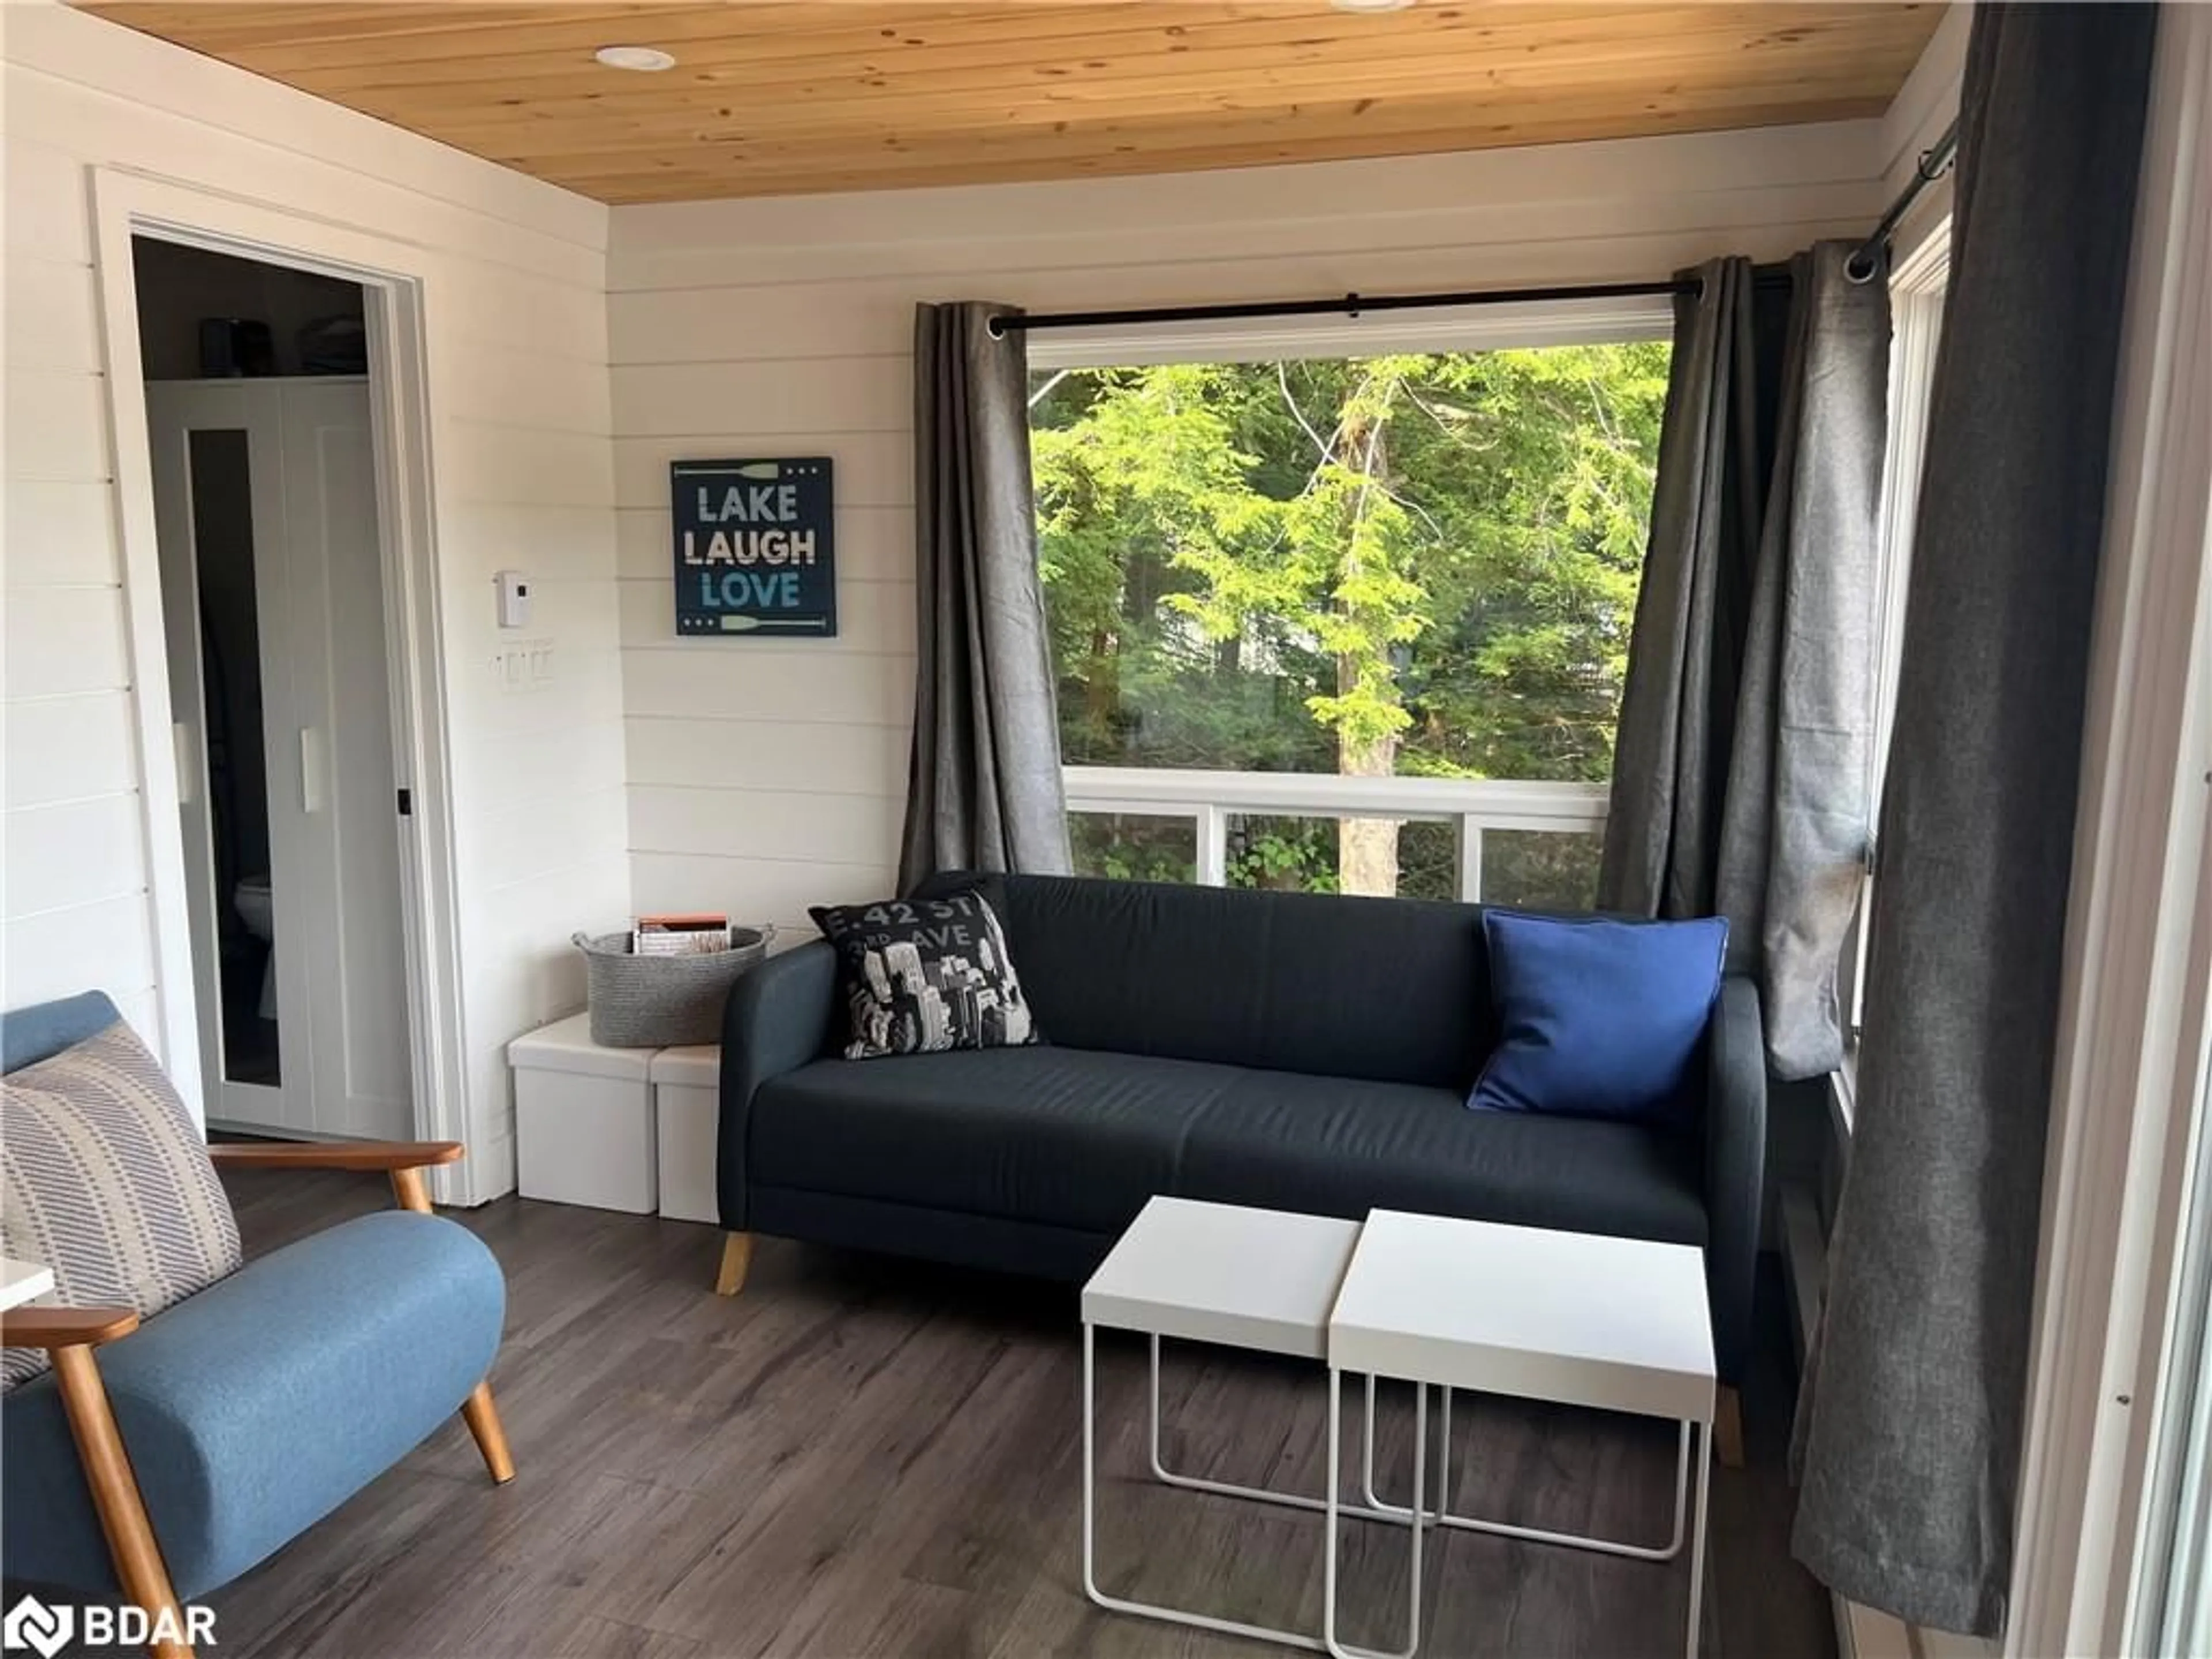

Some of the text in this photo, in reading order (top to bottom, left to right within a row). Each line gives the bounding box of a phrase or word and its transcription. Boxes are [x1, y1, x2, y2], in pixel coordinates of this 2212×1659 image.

[698, 485, 798, 522] LAKE
[684, 529, 816, 565] LAUGH
[700, 572, 800, 608] LOVE
[864, 903, 920, 925] 42
[928, 896, 974, 919] ST
[912, 924, 972, 949] AVE
